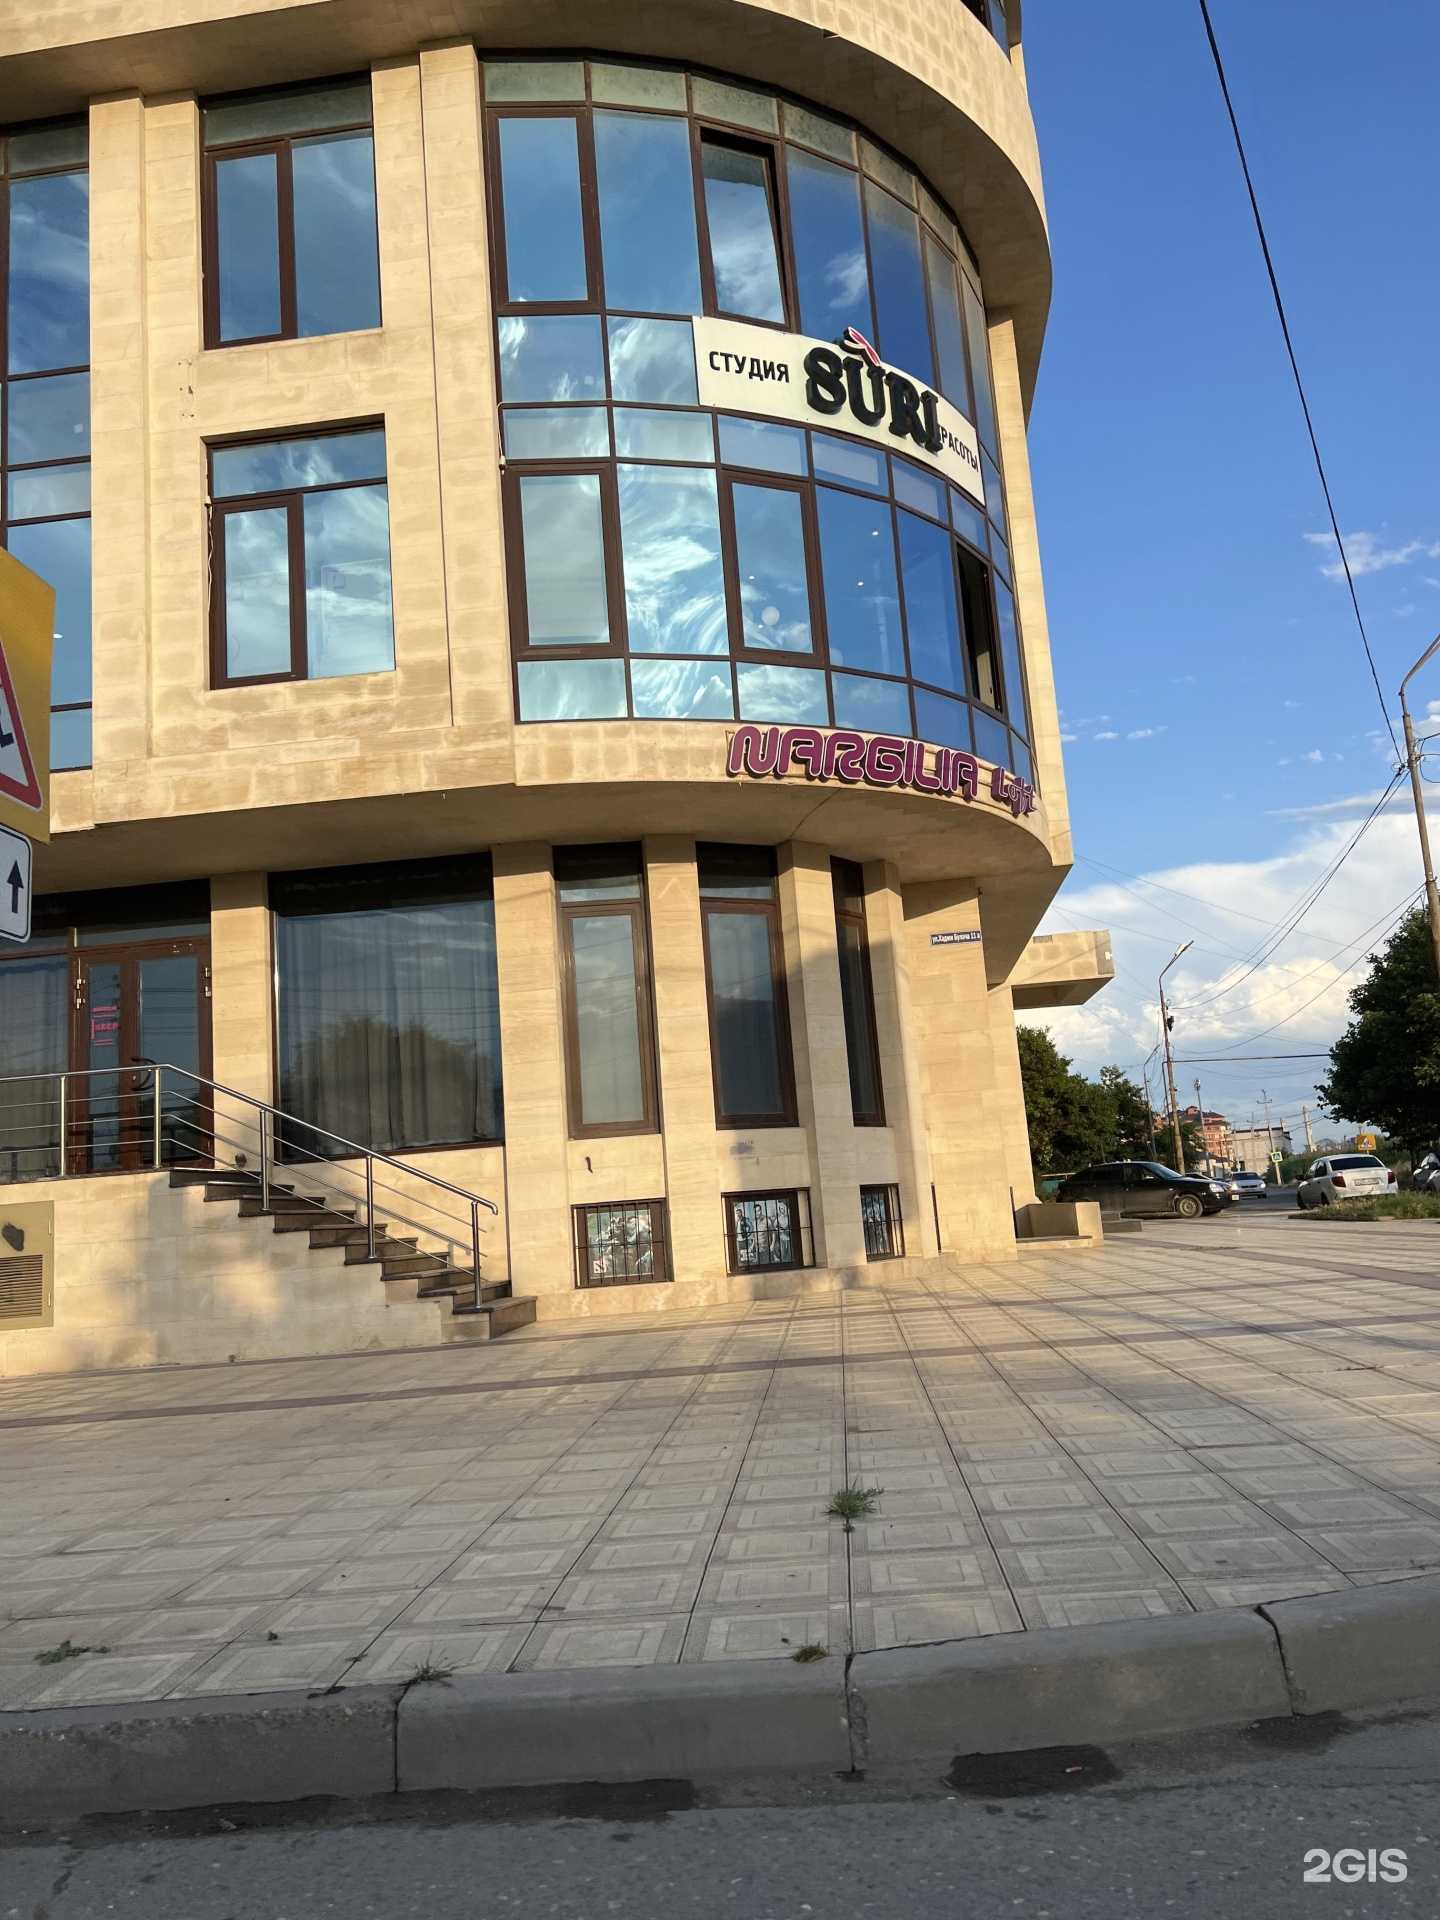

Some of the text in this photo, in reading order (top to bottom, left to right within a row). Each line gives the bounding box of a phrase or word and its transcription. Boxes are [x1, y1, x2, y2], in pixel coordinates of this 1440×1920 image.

[709, 350, 790, 383] СТУДИЯ
[804, 346, 943, 453] SURI
[939, 425, 979, 473] РАСОТЫ
[727, 725, 979, 802] NARGILIA
